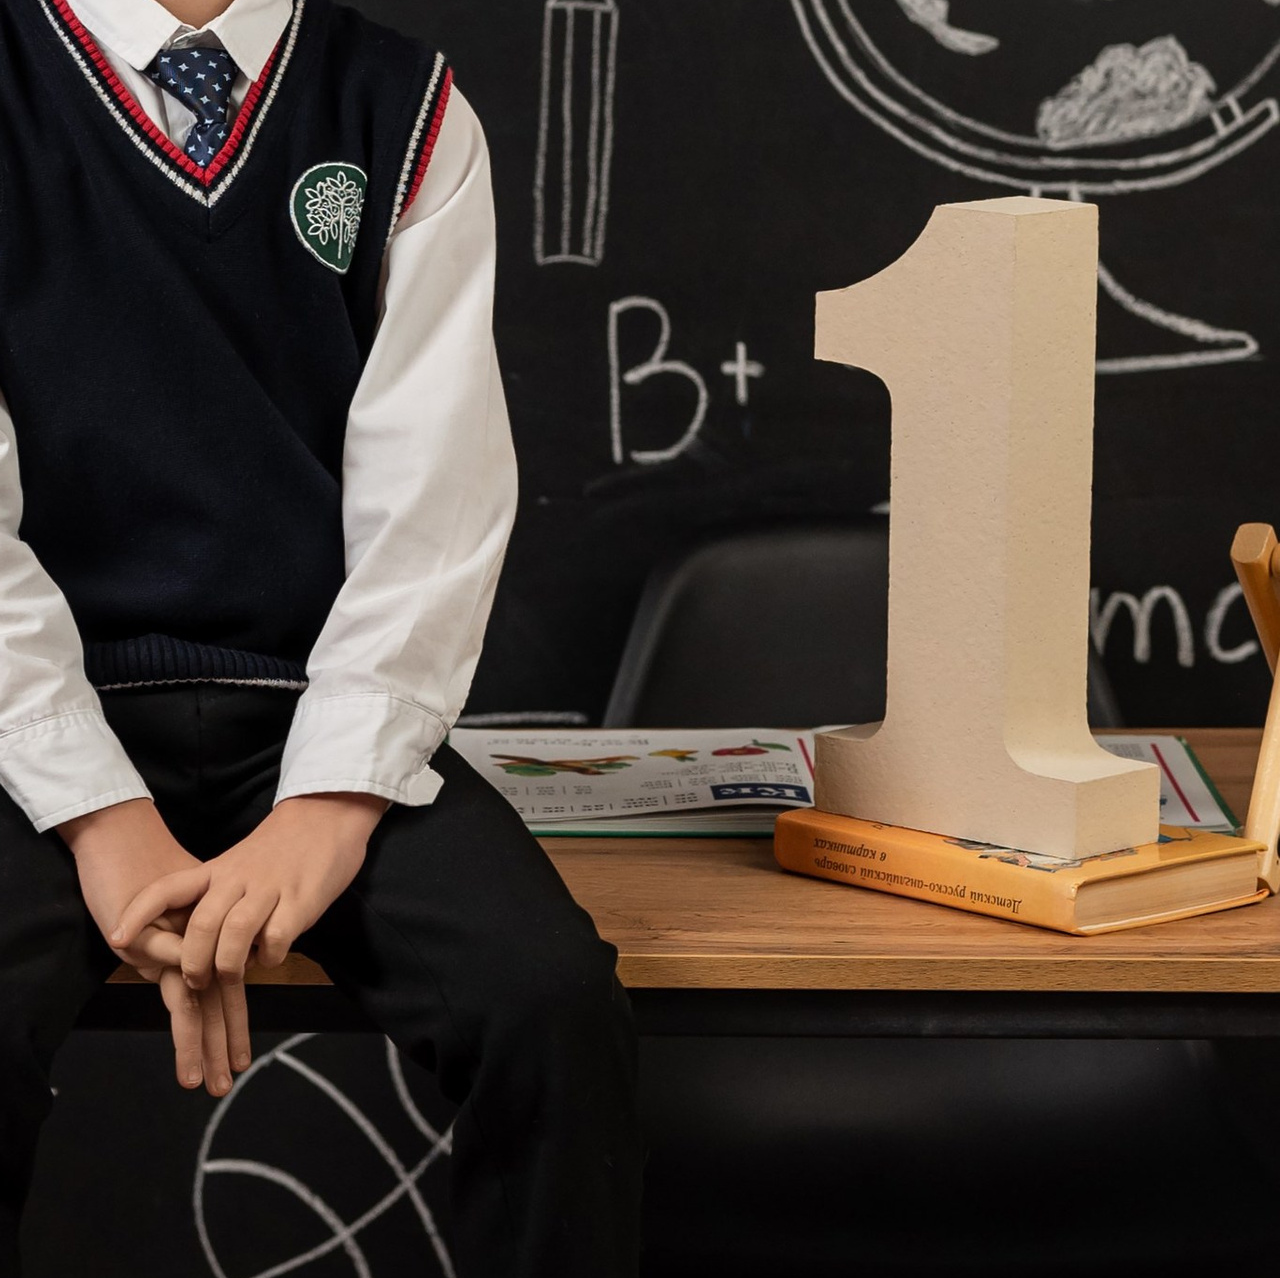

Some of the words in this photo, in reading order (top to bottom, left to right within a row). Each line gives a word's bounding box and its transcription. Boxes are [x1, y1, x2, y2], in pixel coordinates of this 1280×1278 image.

[814, 196, 1161, 863] 1
[813, 836, 876, 860] картинках
[879, 851, 887, 862] в
[814, 858, 856, 876] словарь
[860, 867, 967, 899] русско-английский
[970, 890, 1023, 914] Детский
